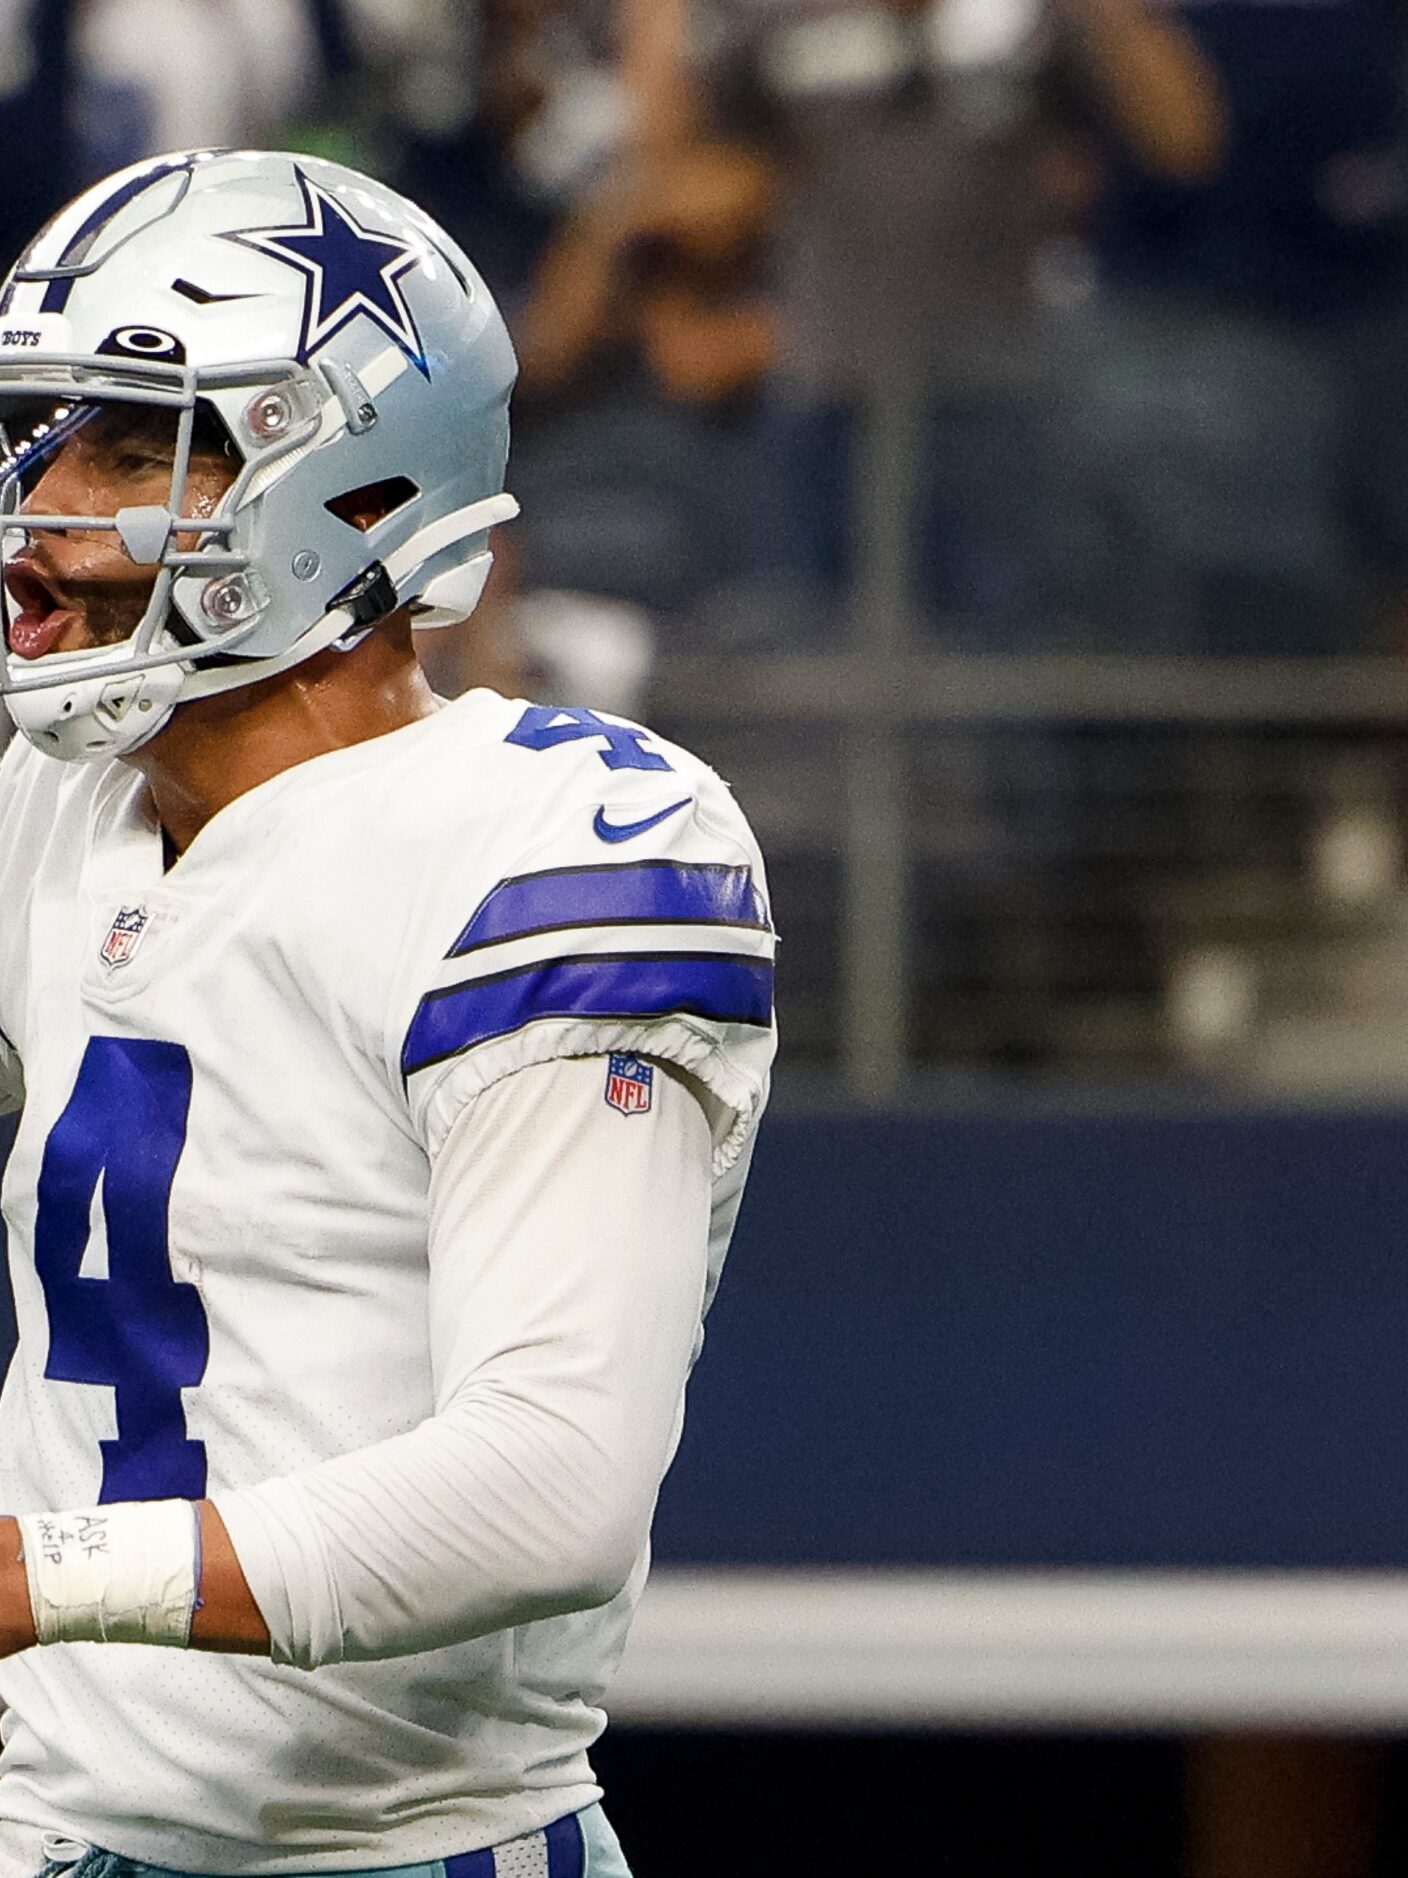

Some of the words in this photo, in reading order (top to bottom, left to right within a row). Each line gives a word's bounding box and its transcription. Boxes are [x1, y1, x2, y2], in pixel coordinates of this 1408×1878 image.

[503, 706, 676, 772] 4
[609, 1077, 647, 1110] NFL
[34, 1035, 209, 1505] 4
[73, 1516, 110, 1559] ASK
